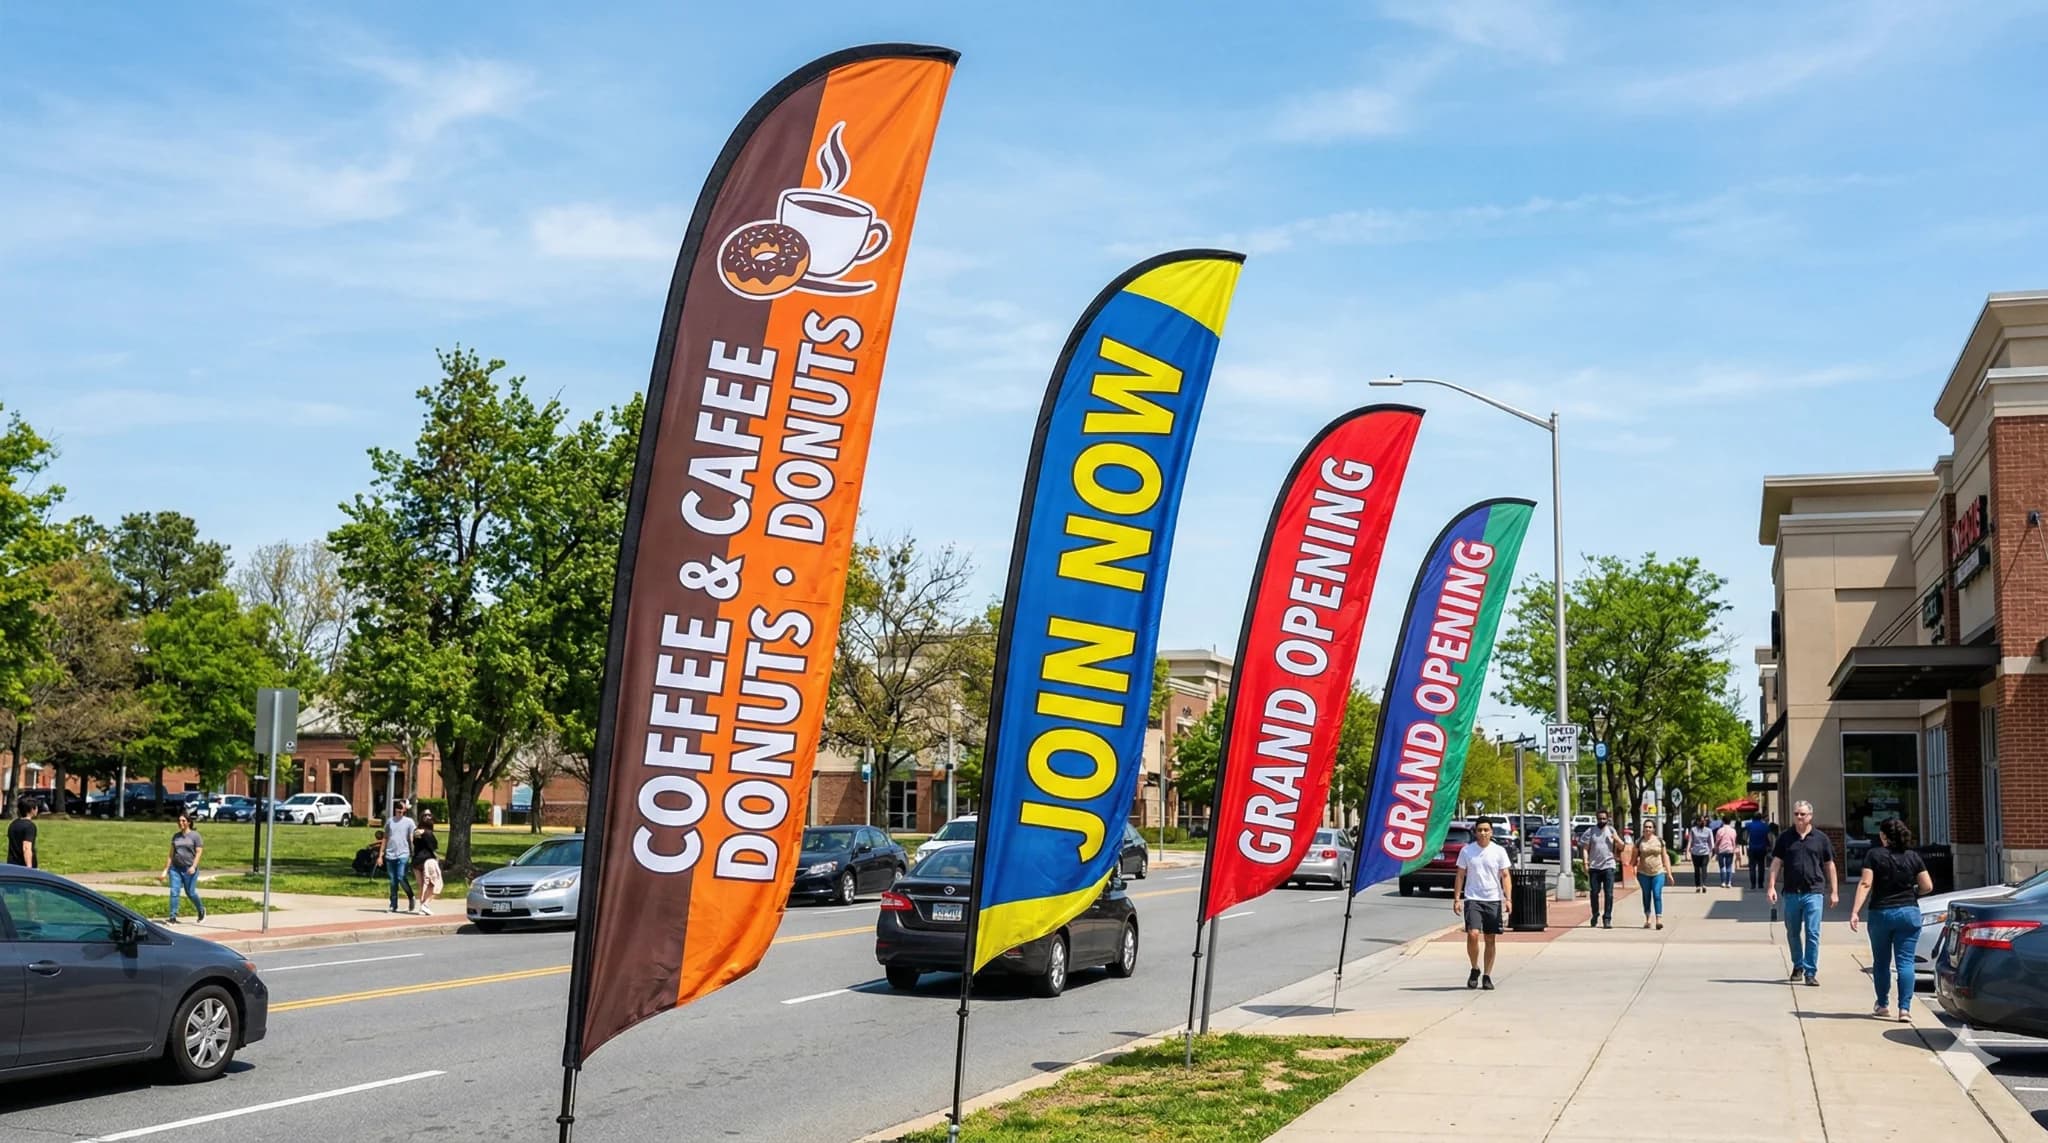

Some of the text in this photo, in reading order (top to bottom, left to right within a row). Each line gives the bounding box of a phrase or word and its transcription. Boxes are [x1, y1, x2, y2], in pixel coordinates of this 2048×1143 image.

[633, 339, 778, 874] COFFEE & CAFEE
[713, 607, 814, 883] DONUTS
[765, 309, 863, 545] DONUTS
[1018, 336, 1184, 864] JOIN NOW
[1238, 455, 1375, 865] GRAND OPENING
[1382, 537, 1496, 861] GRAND OPENING
